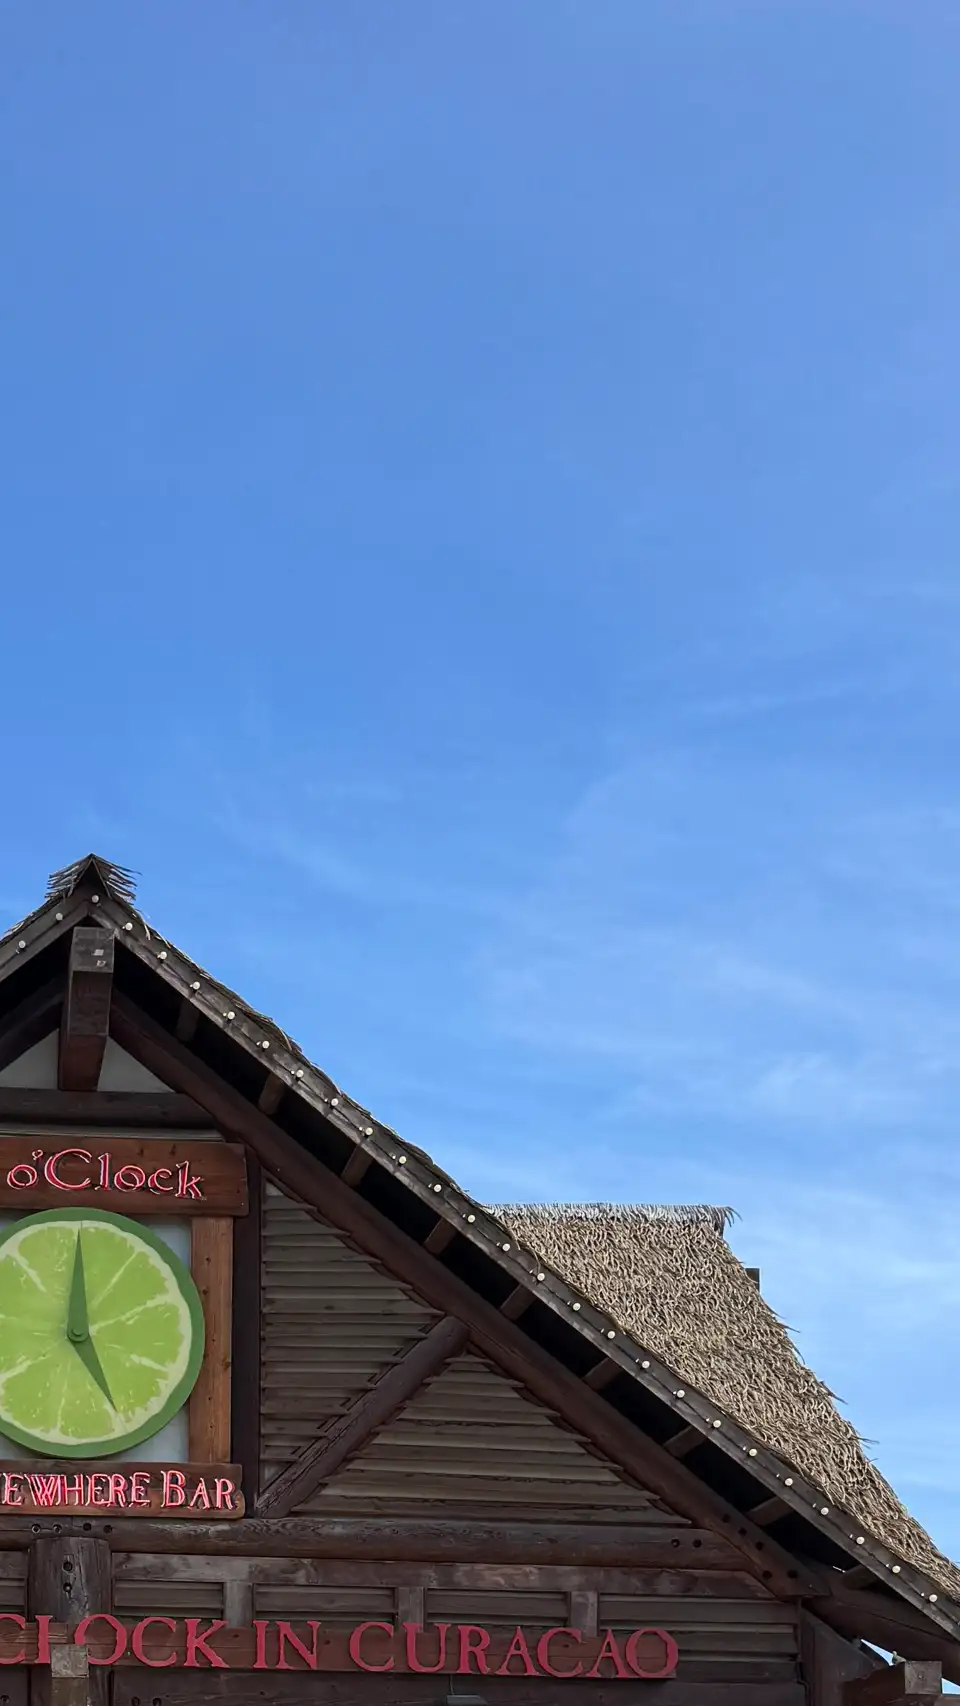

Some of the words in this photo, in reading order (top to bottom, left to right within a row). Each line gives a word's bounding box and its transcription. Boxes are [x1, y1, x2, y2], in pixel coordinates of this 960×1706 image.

[160, 1469, 237, 1511] BAR
[252, 1619, 321, 1671] IN
[349, 1620, 681, 1679] CURACAO
